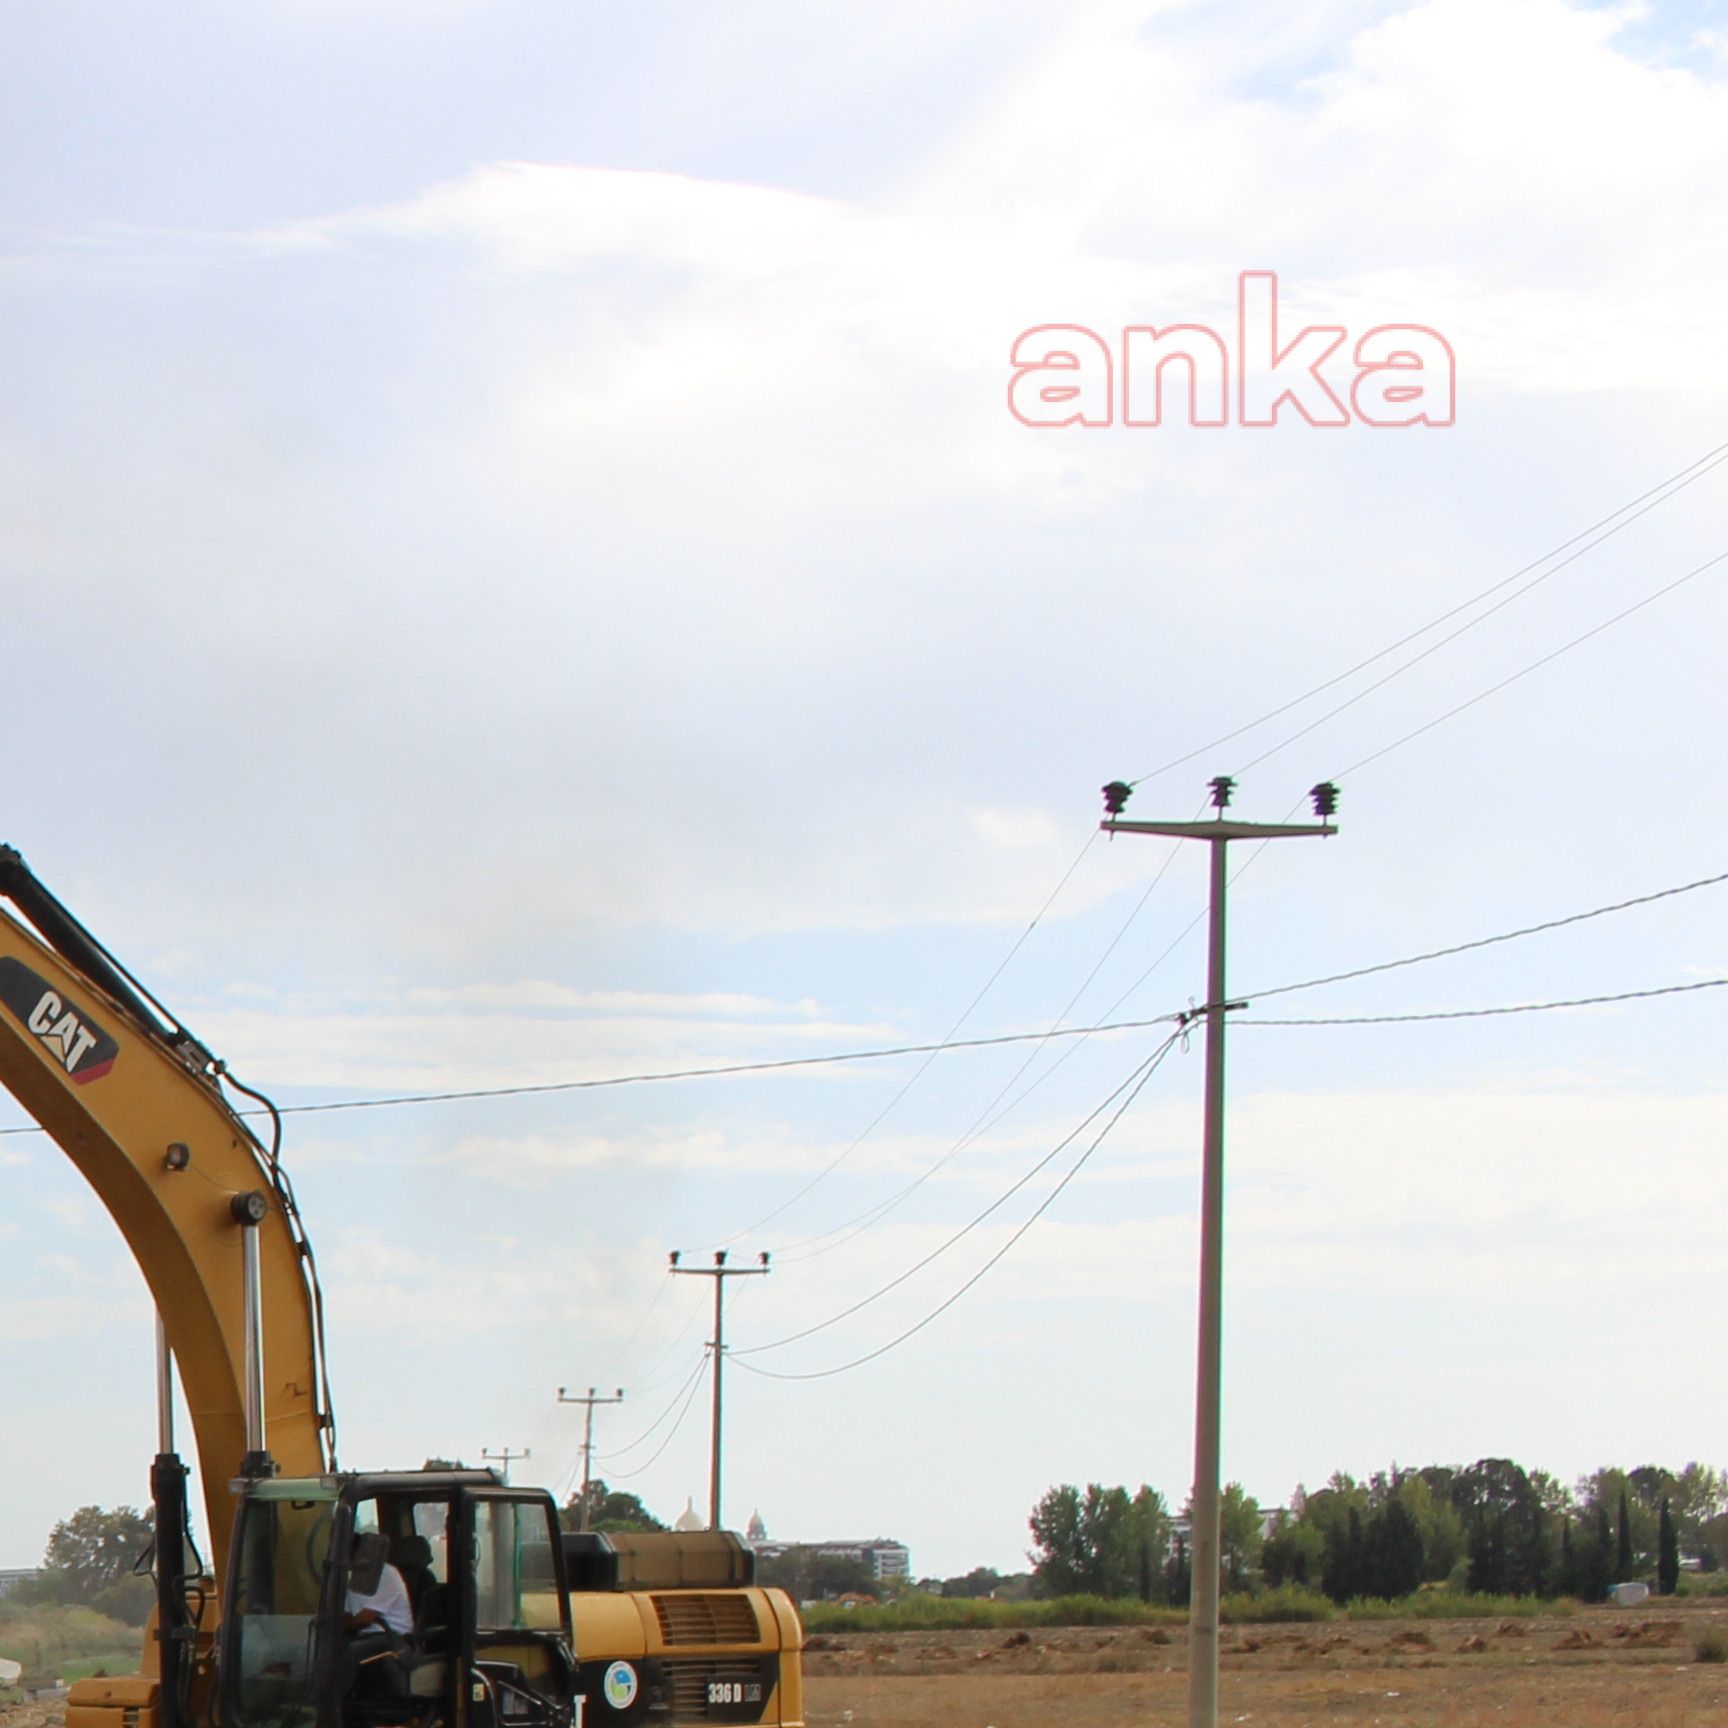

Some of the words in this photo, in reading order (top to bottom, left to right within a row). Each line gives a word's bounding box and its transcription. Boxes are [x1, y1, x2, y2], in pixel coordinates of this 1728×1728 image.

[28, 991, 97, 1073] CAT
[708, 1682, 732, 1703] 336
[733, 1682, 742, 1703] D
